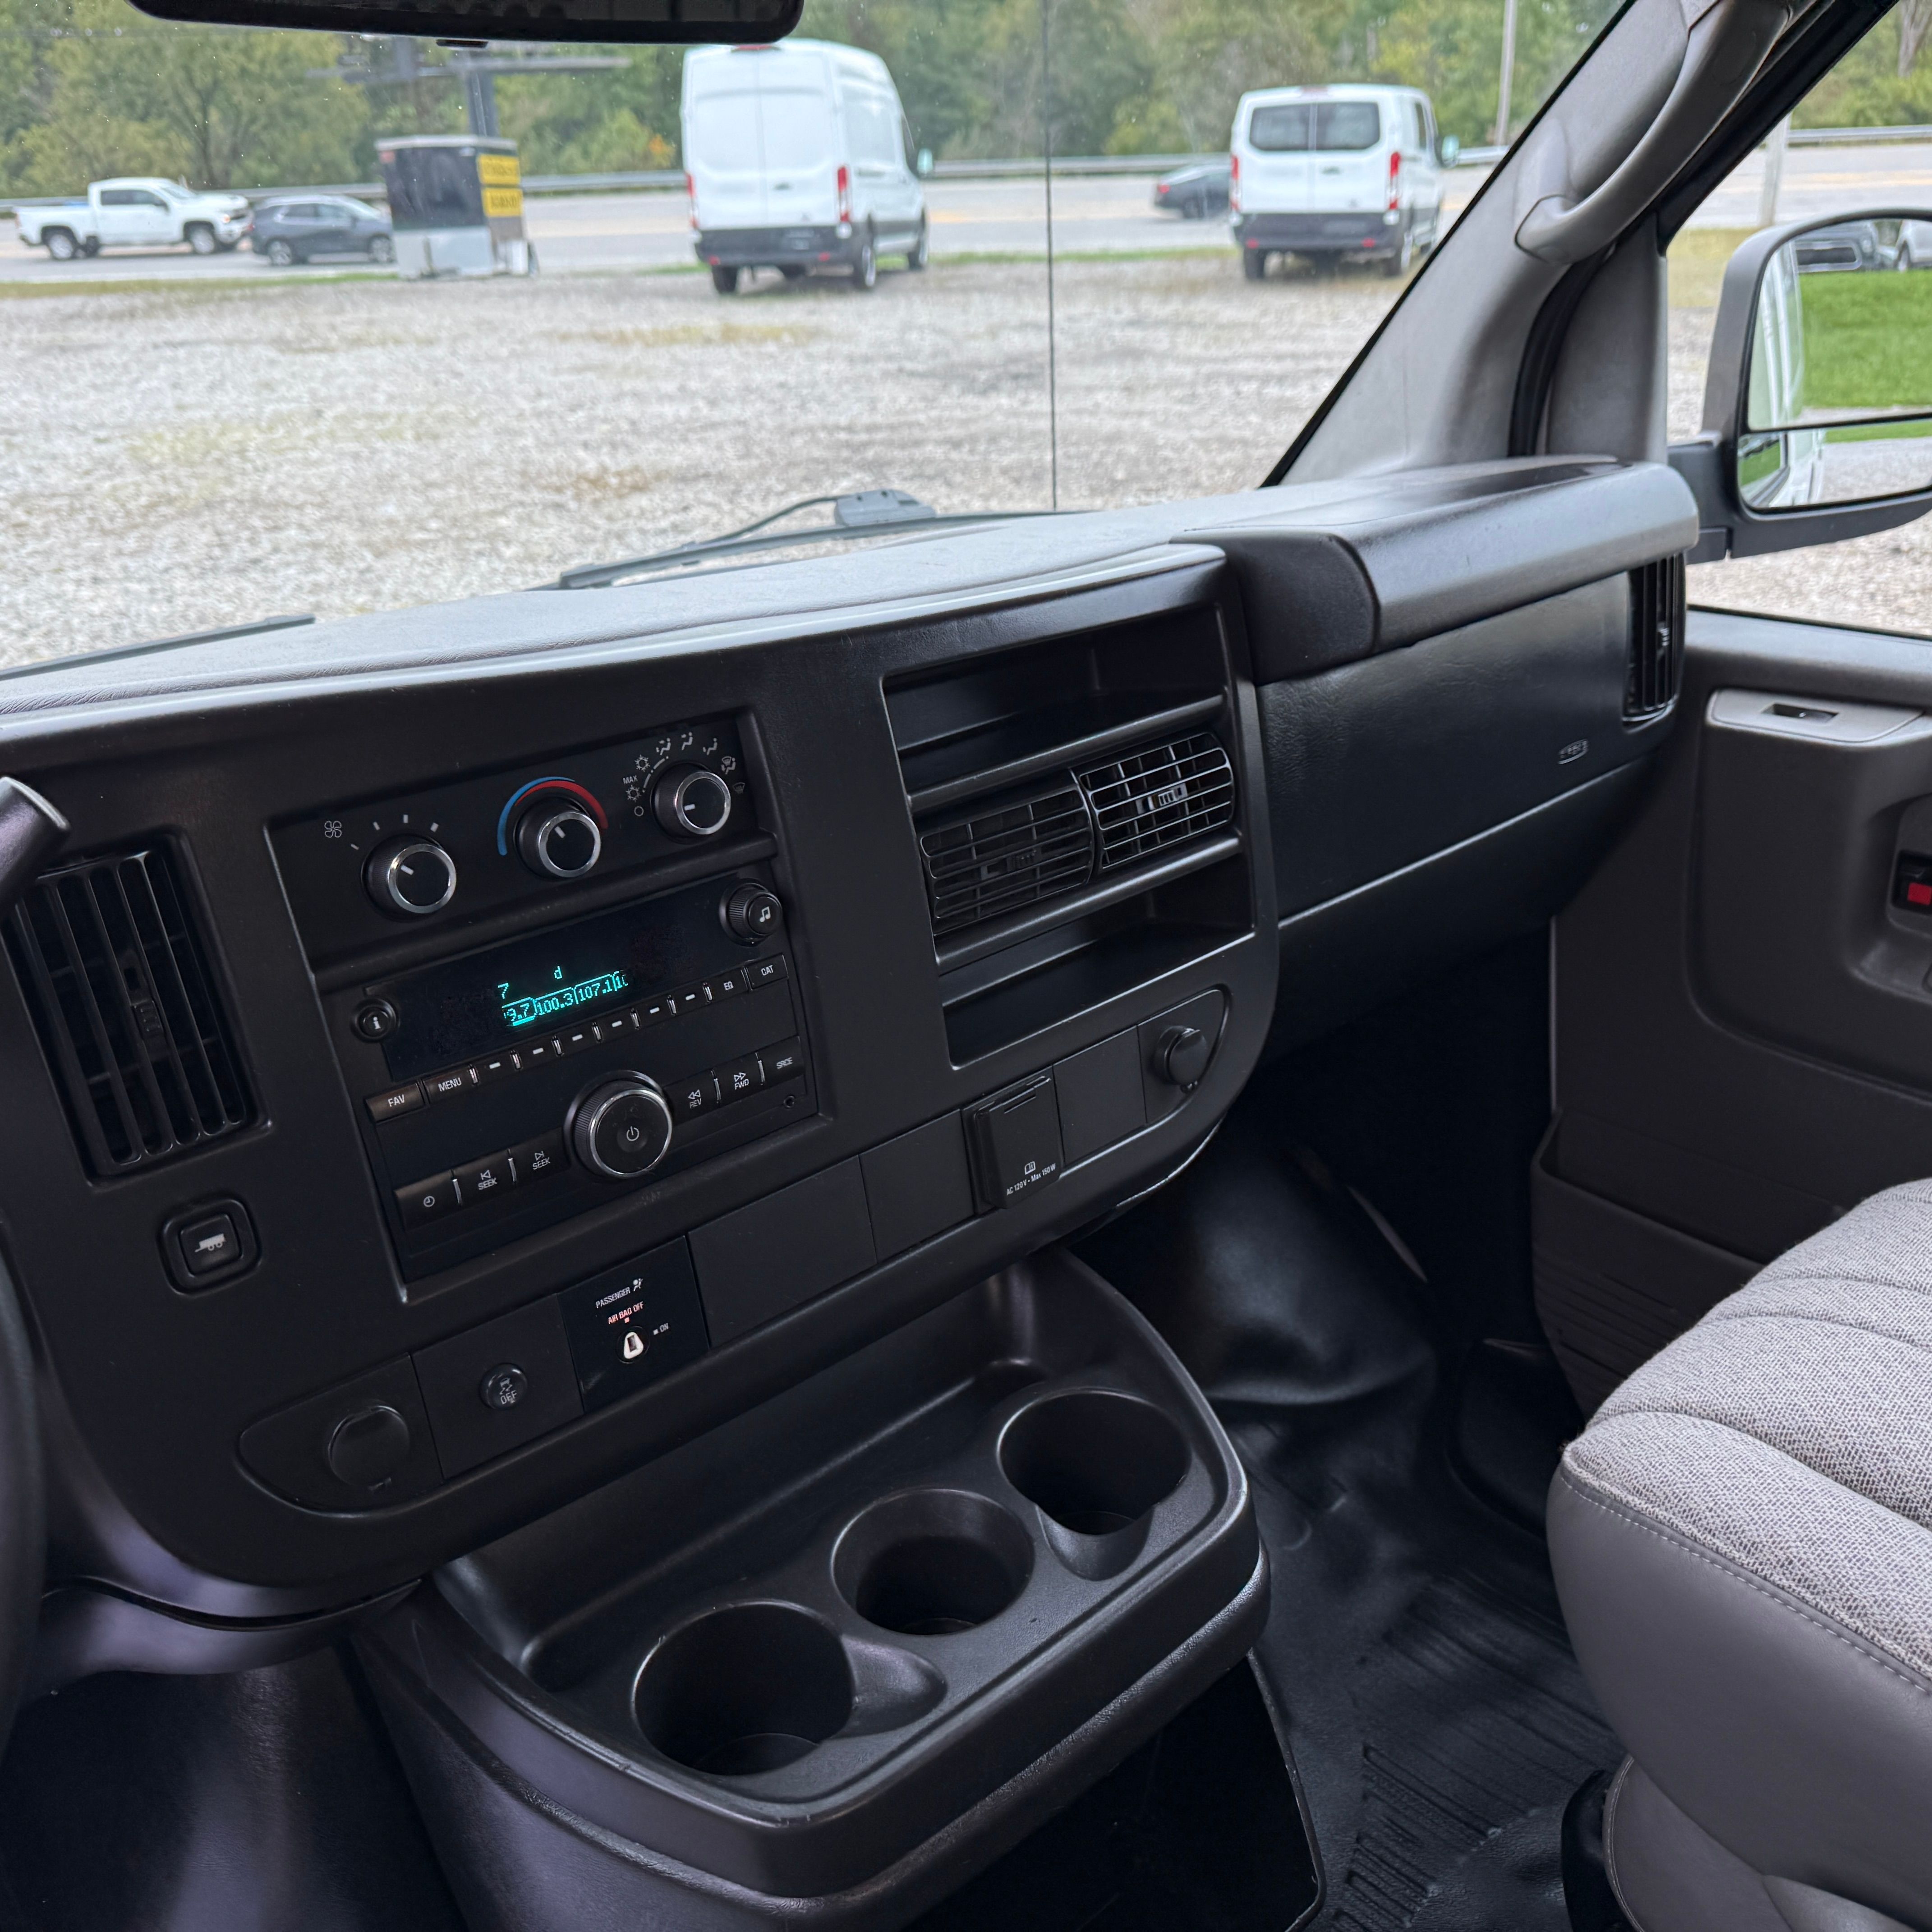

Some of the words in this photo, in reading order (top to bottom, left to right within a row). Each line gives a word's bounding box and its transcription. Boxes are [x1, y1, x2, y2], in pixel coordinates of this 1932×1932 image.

[623, 775, 638, 784] MAX
[761, 965, 773, 976] CAT
[537, 993, 574, 1016] 100.3
[578, 979, 613, 1002] 107.1
[776, 1057, 794, 1069] SRCE
[438, 1077, 462, 1092] MENU
[735, 1079, 750, 1090] FWD
[388, 1094, 405, 1107] FAV
[690, 1098, 702, 1109] REV
[533, 1157, 551, 1170] SEEK
[478, 1178, 497, 1190] SEEK
[1006, 1187, 1013, 1196] AC
[1031, 1173, 1042, 1182] Max
[595, 1287, 631, 1309] PASSENGER
[608, 1314, 619, 1325] AIR
[618, 1307, 632, 1320] BAG
[633, 1301, 644, 1312] OFF
[659, 1323, 669, 1332] ON
[500, 1390, 518, 1405] OFF
